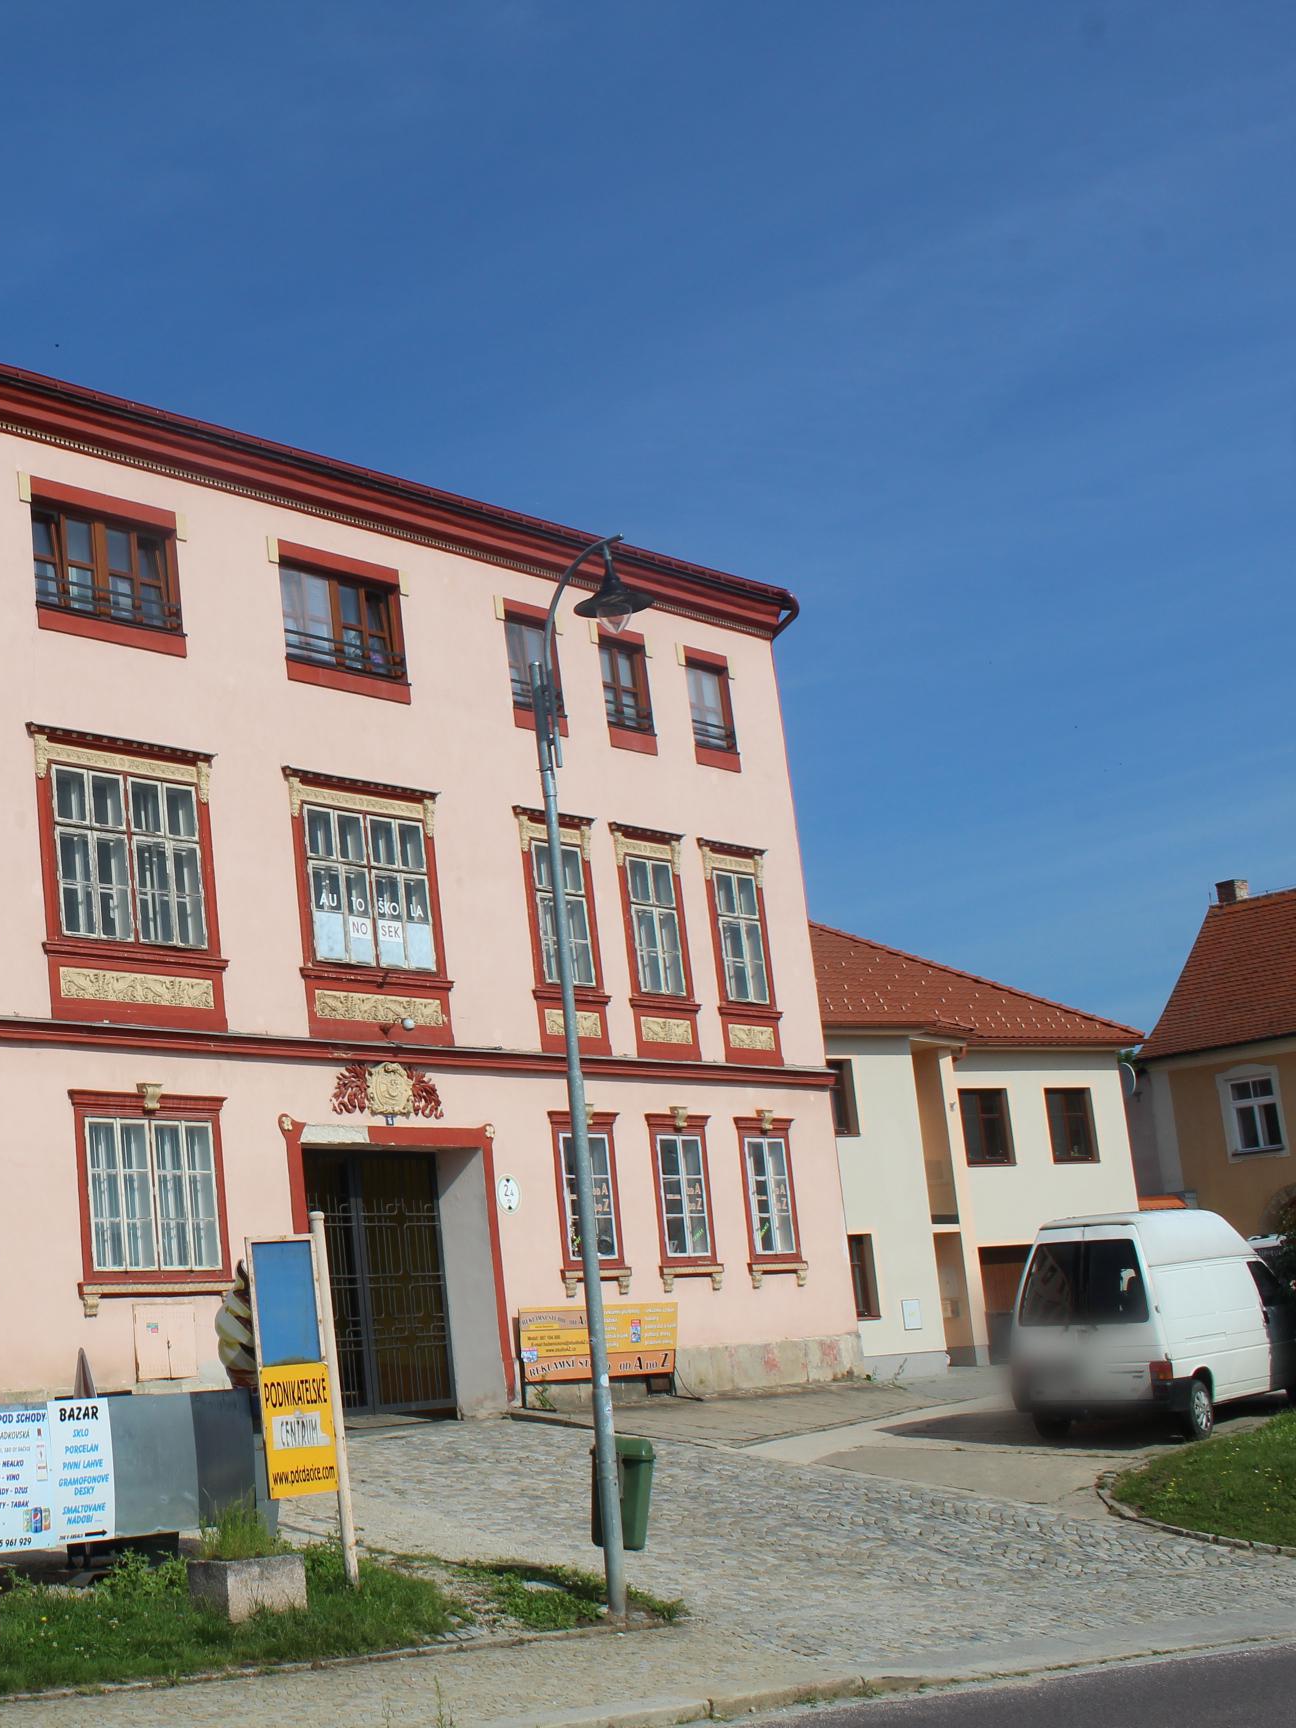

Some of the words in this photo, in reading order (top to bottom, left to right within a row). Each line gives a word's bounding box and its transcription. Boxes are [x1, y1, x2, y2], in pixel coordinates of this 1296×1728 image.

[634, 1356, 643, 1370] A
[660, 1352, 669, 1367] Z
[264, 1373, 328, 1409] PODNIKATELSKÉ
[16, 1412, 46, 1423] SCHODY
[59, 1406, 98, 1422] BAZAR
[73, 1429, 89, 1437] SKLO
[280, 1419, 320, 1448] CENTRUM
[74, 1486, 95, 1496] DESKY
[6, 1538, 17, 1547] 961
[19, 1537, 32, 1546] 929
